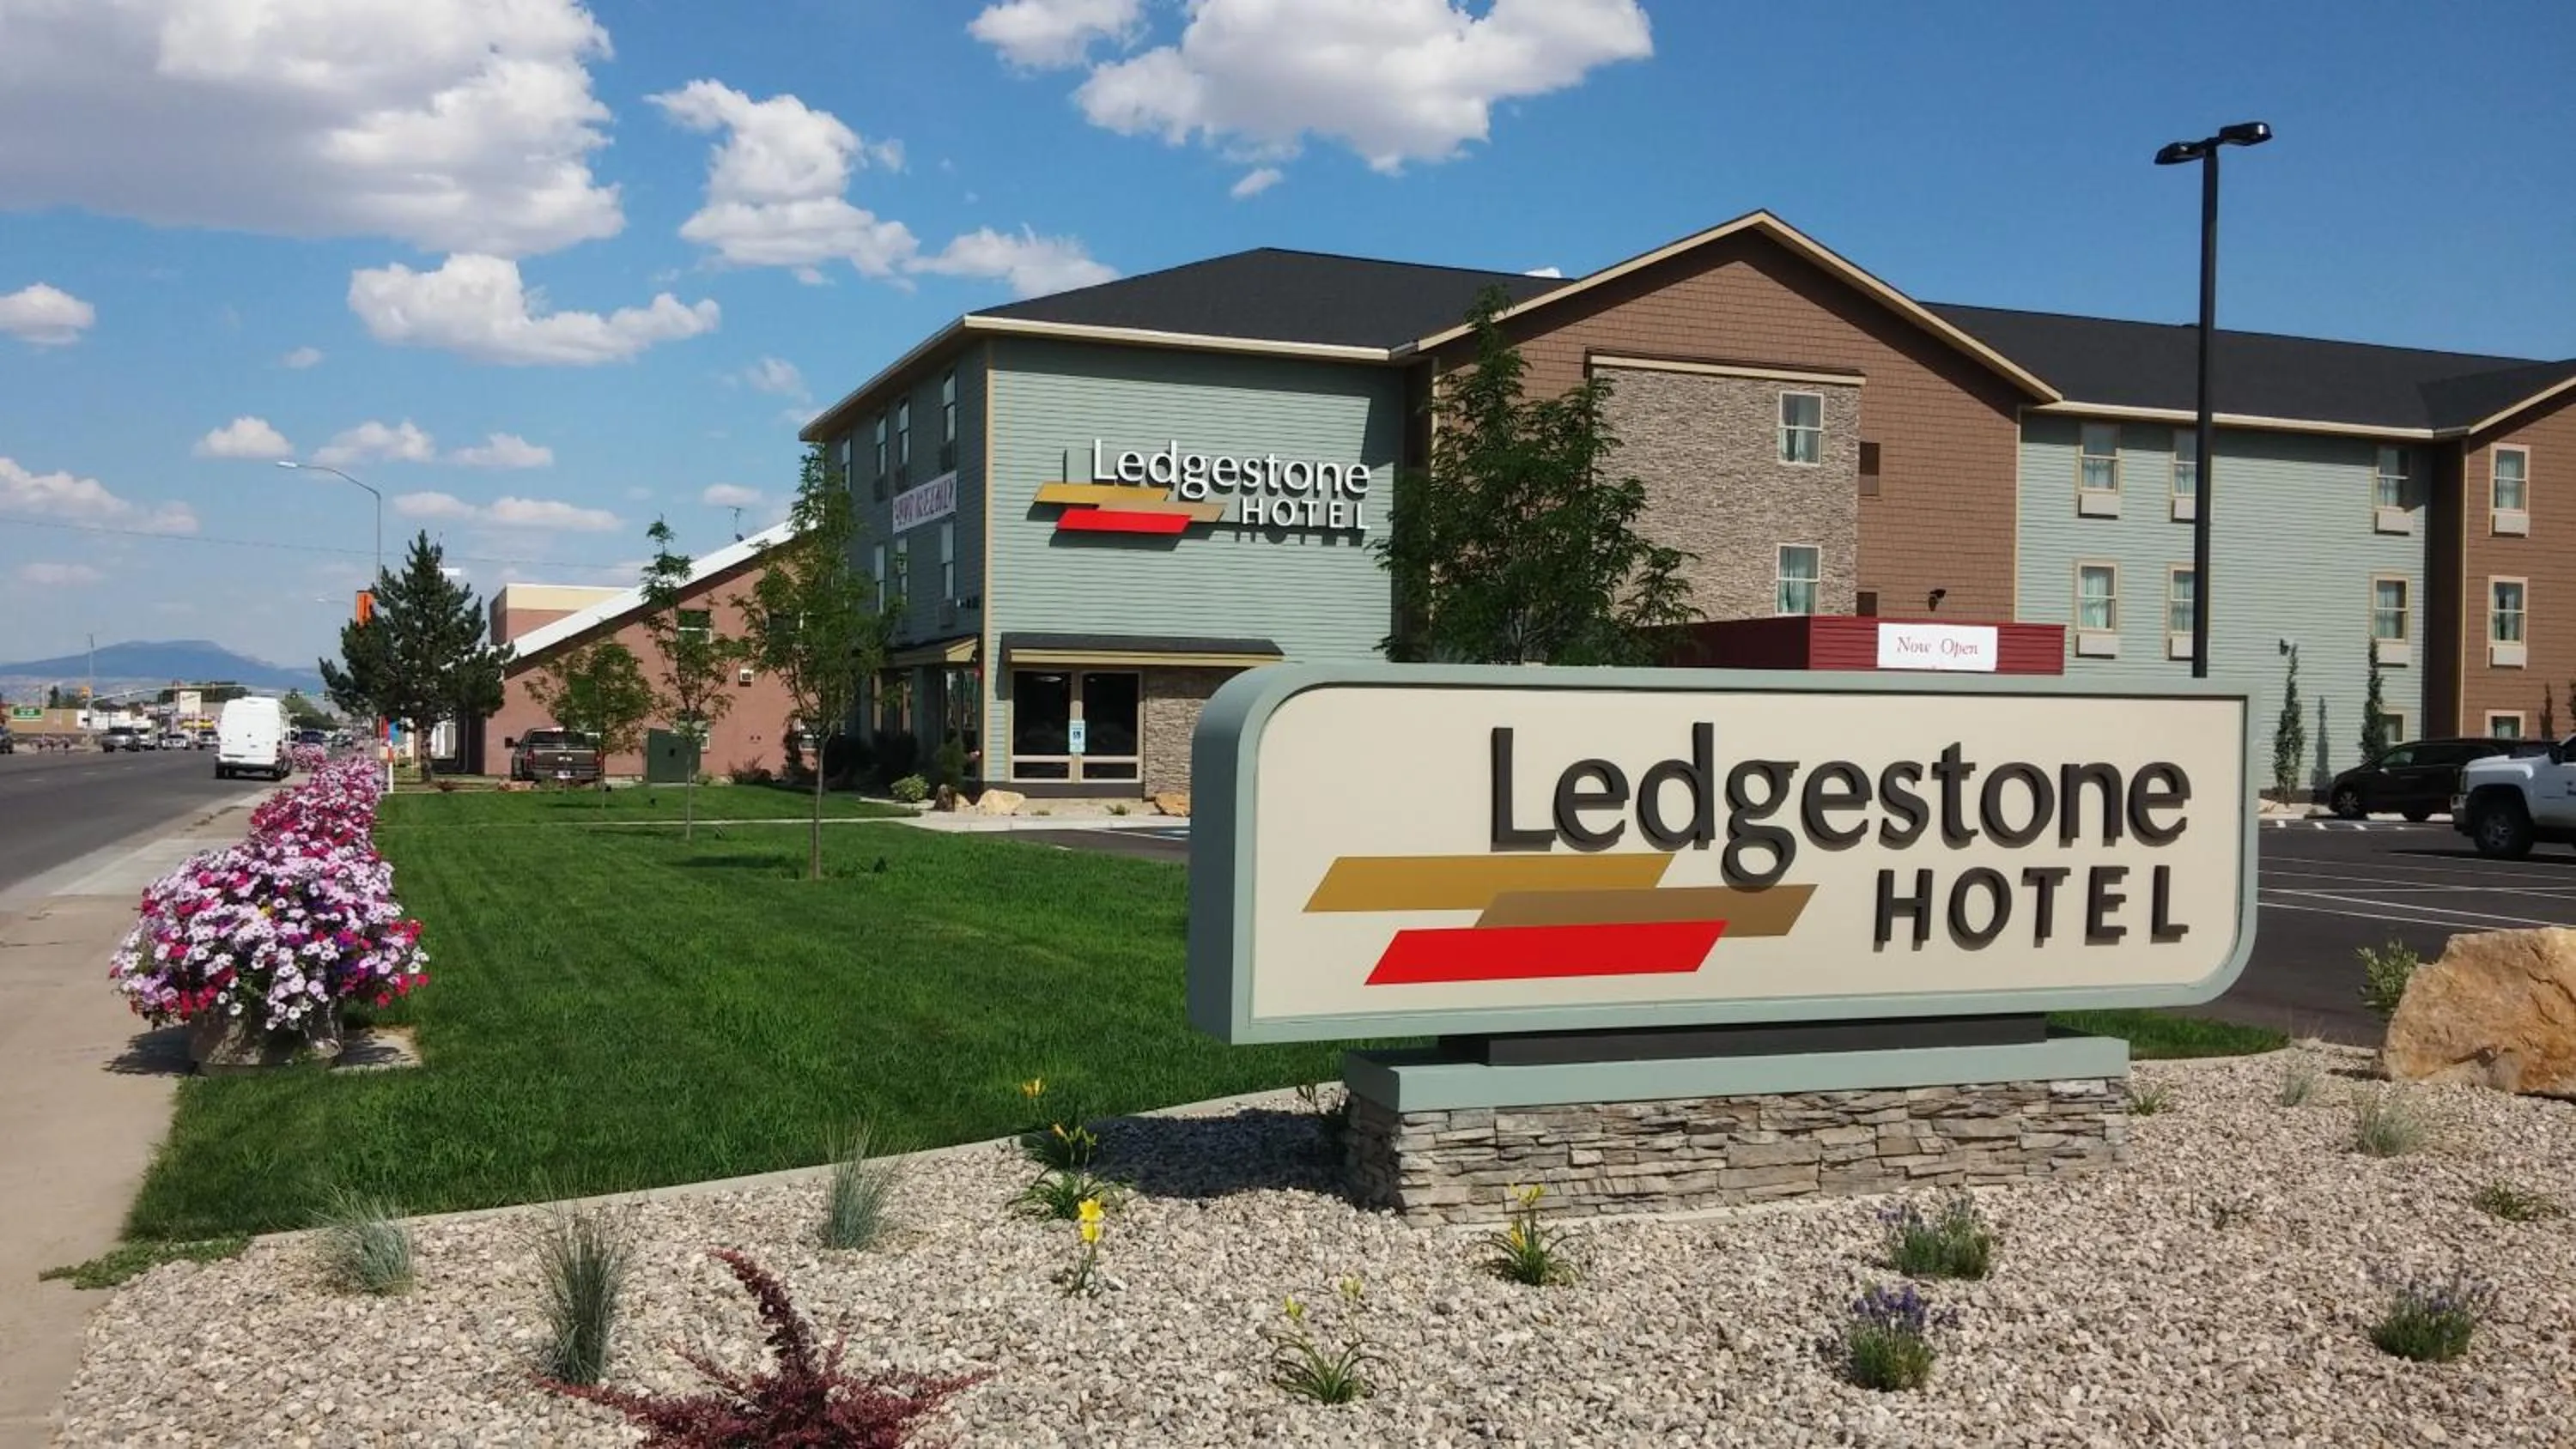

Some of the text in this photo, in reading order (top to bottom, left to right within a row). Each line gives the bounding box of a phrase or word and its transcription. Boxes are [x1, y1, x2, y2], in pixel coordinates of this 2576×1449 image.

[1093, 438, 1371, 500] Ledgestone
[1242, 498, 1372, 530] HOTEL
[1897, 636, 1978, 658] Now Open
[1490, 722, 2191, 890] Ledgestone
[1874, 865, 2190, 952] HOTEL
